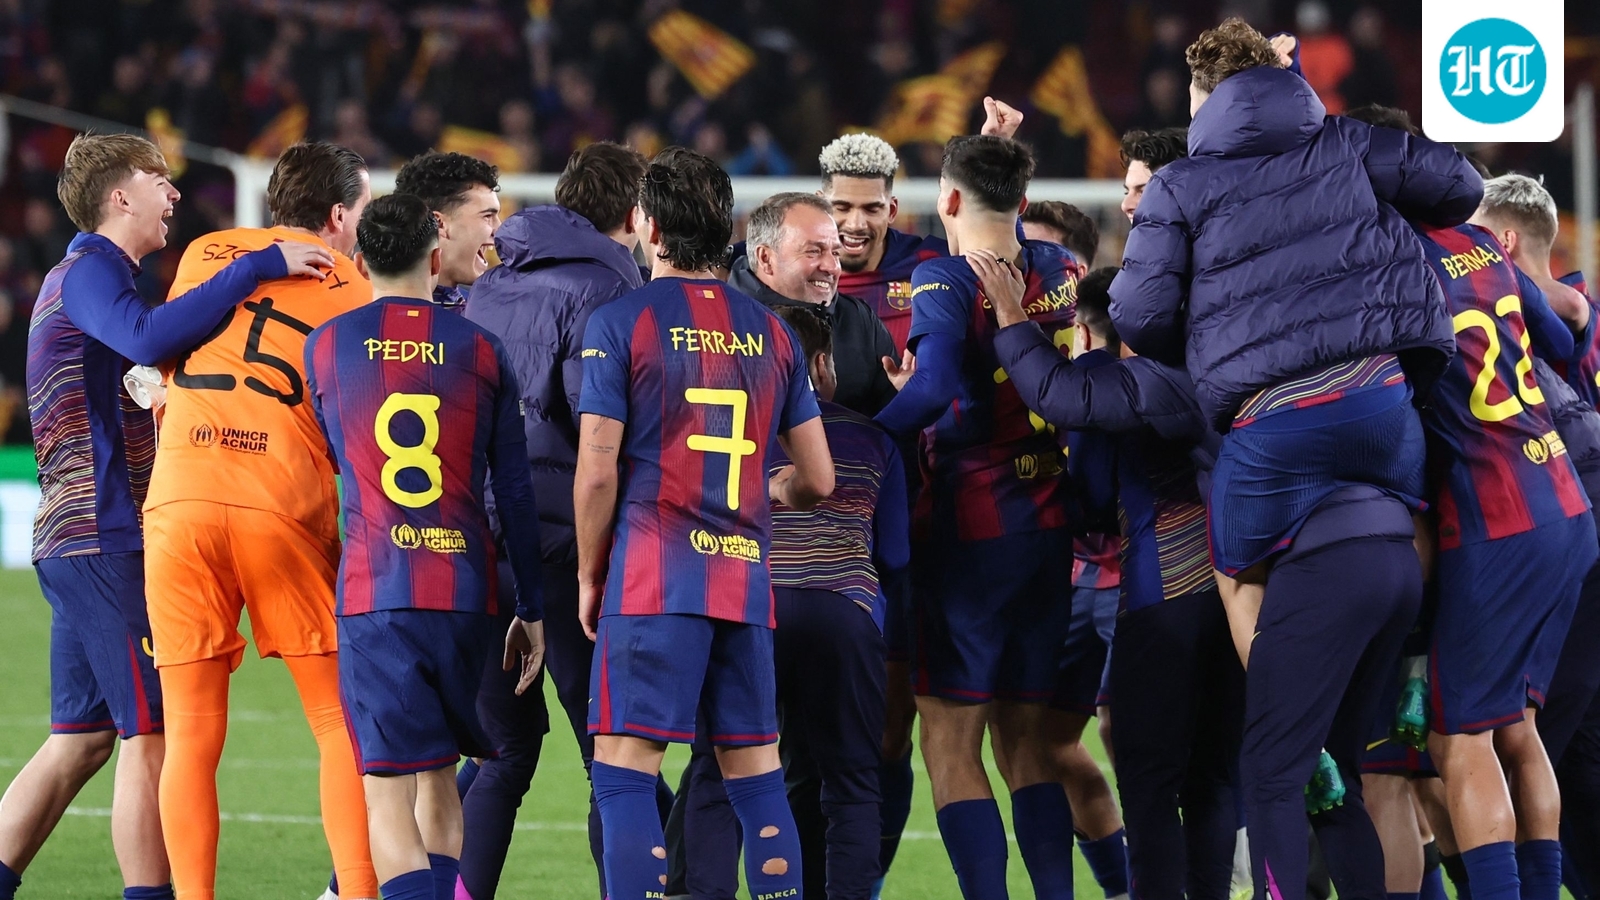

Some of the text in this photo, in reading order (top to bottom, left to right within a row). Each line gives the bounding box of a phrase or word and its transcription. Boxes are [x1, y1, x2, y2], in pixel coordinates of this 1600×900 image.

[669, 327, 763, 357] FERRAN
[173, 297, 314, 407] 25
[363, 337, 444, 365] PEDRI
[1453, 295, 1545, 422] 22
[221, 427, 268, 442] UNHCR
[220, 437, 267, 452] ACNUR
[374, 392, 444, 509] 8
[684, 387, 757, 511] 7
[420, 527, 464, 539] UNHCR
[424, 538, 467, 549] ACNUR
[718, 535, 760, 549] UNHCR
[722, 544, 760, 559] ACNUR
[757, 887, 797, 900] BARÇA
